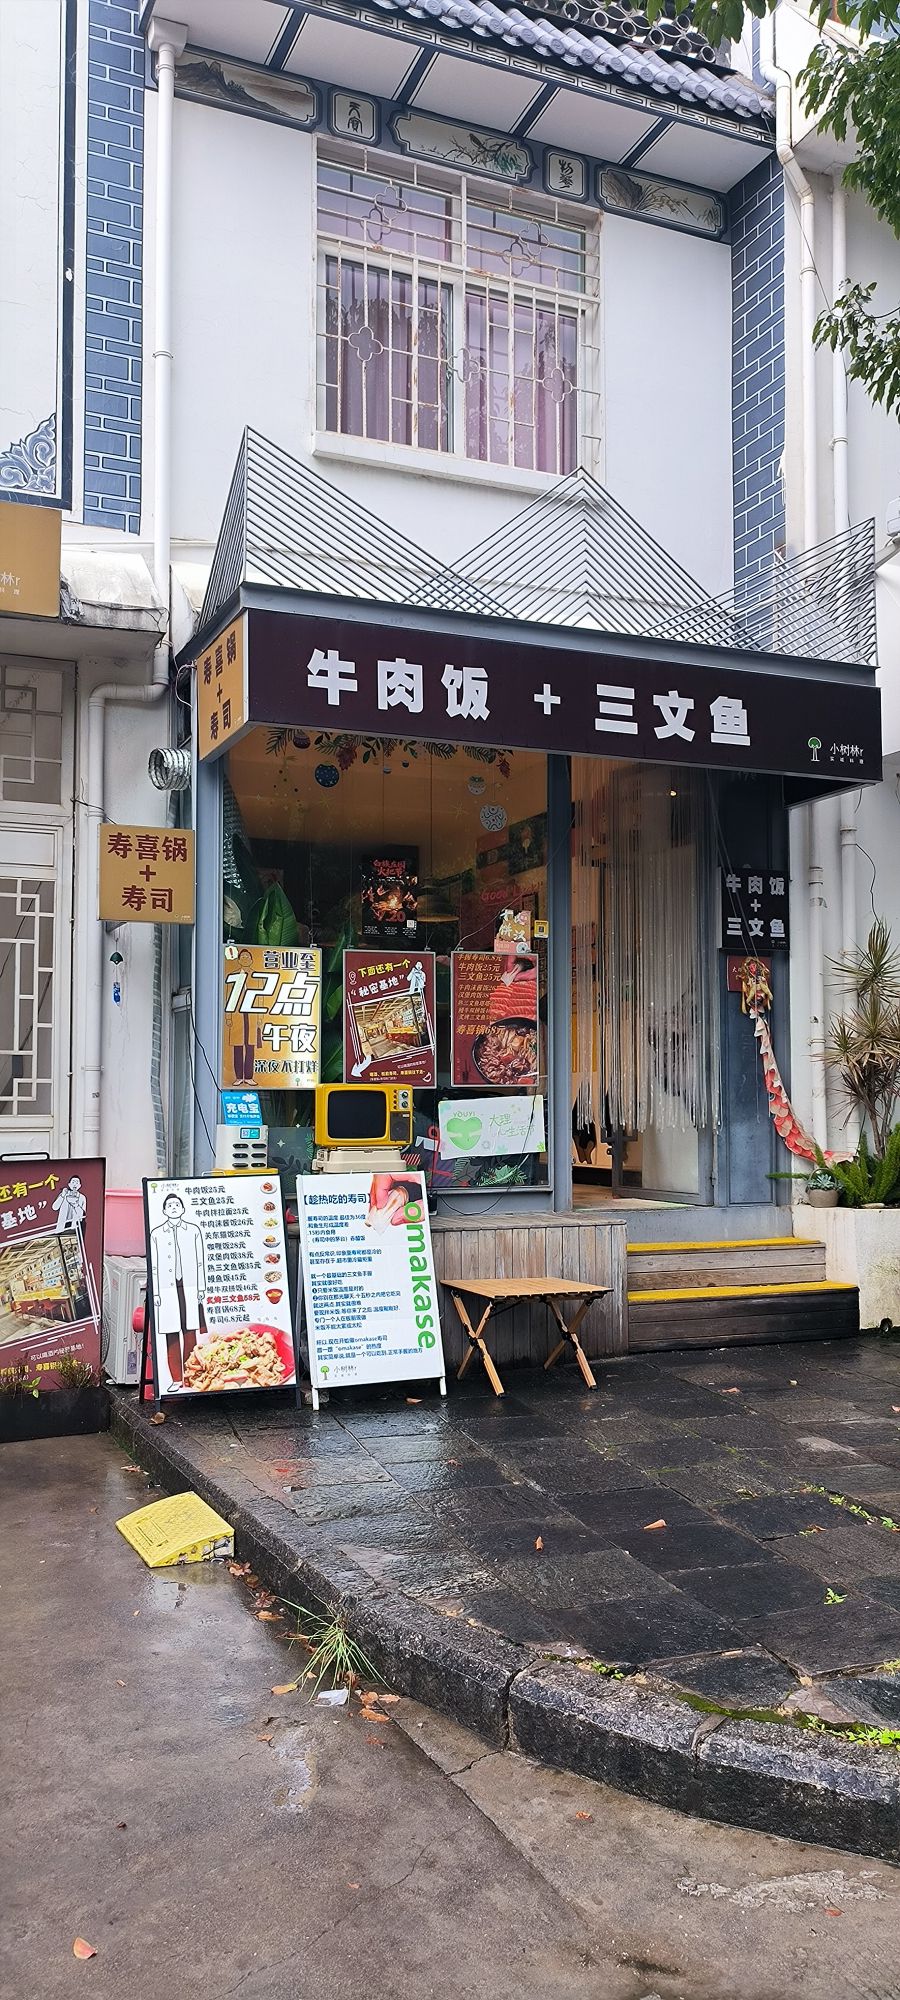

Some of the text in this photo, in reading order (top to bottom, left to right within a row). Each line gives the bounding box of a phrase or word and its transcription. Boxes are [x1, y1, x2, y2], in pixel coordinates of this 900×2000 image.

[203, 630, 236, 685] 寿喜锅
[307, 648, 751, 746] 牛肉饭 + 三文鱼
[210, 698, 231, 740] 寿司
[107, 832, 187, 862] 寿喜锅
[139, 864, 157, 882] +
[726, 873, 785, 895] 牛肉饭
[121, 885, 174, 912] 寿司
[750, 899, 761, 912] +
[726, 917, 785, 938] 三文鱼
[263, 950, 316, 971] 营业至
[358, 959, 411, 978] 下面还有一个
[458, 963, 500, 972] 牛肉饭25元
[458, 972, 502, 981] 三文鱼25元
[224, 971, 320, 1016] 12点
[262, 1023, 317, 1052] 午夜
[254, 1059, 318, 1075] 深夜不打烊
[226, 1102, 260, 1114] 充电宝
[490, 1113, 511, 1126] 大理
[185, 1185, 226, 1195] 牛肉饭25元
[190, 1196, 234, 1206] 三文鱼25元
[206, 1241, 246, 1251] 咖喱饭28元
[207, 1251, 254, 1261] 汉堡肉饭38元
[207, 1273, 247, 1283] 鳗鱼饭45元
[404, 1201, 436, 1348] omakase
[207, 1304, 246, 1315] 寿喜锅68元
[209, 1313, 250, 1324] 寿司6.8元起
